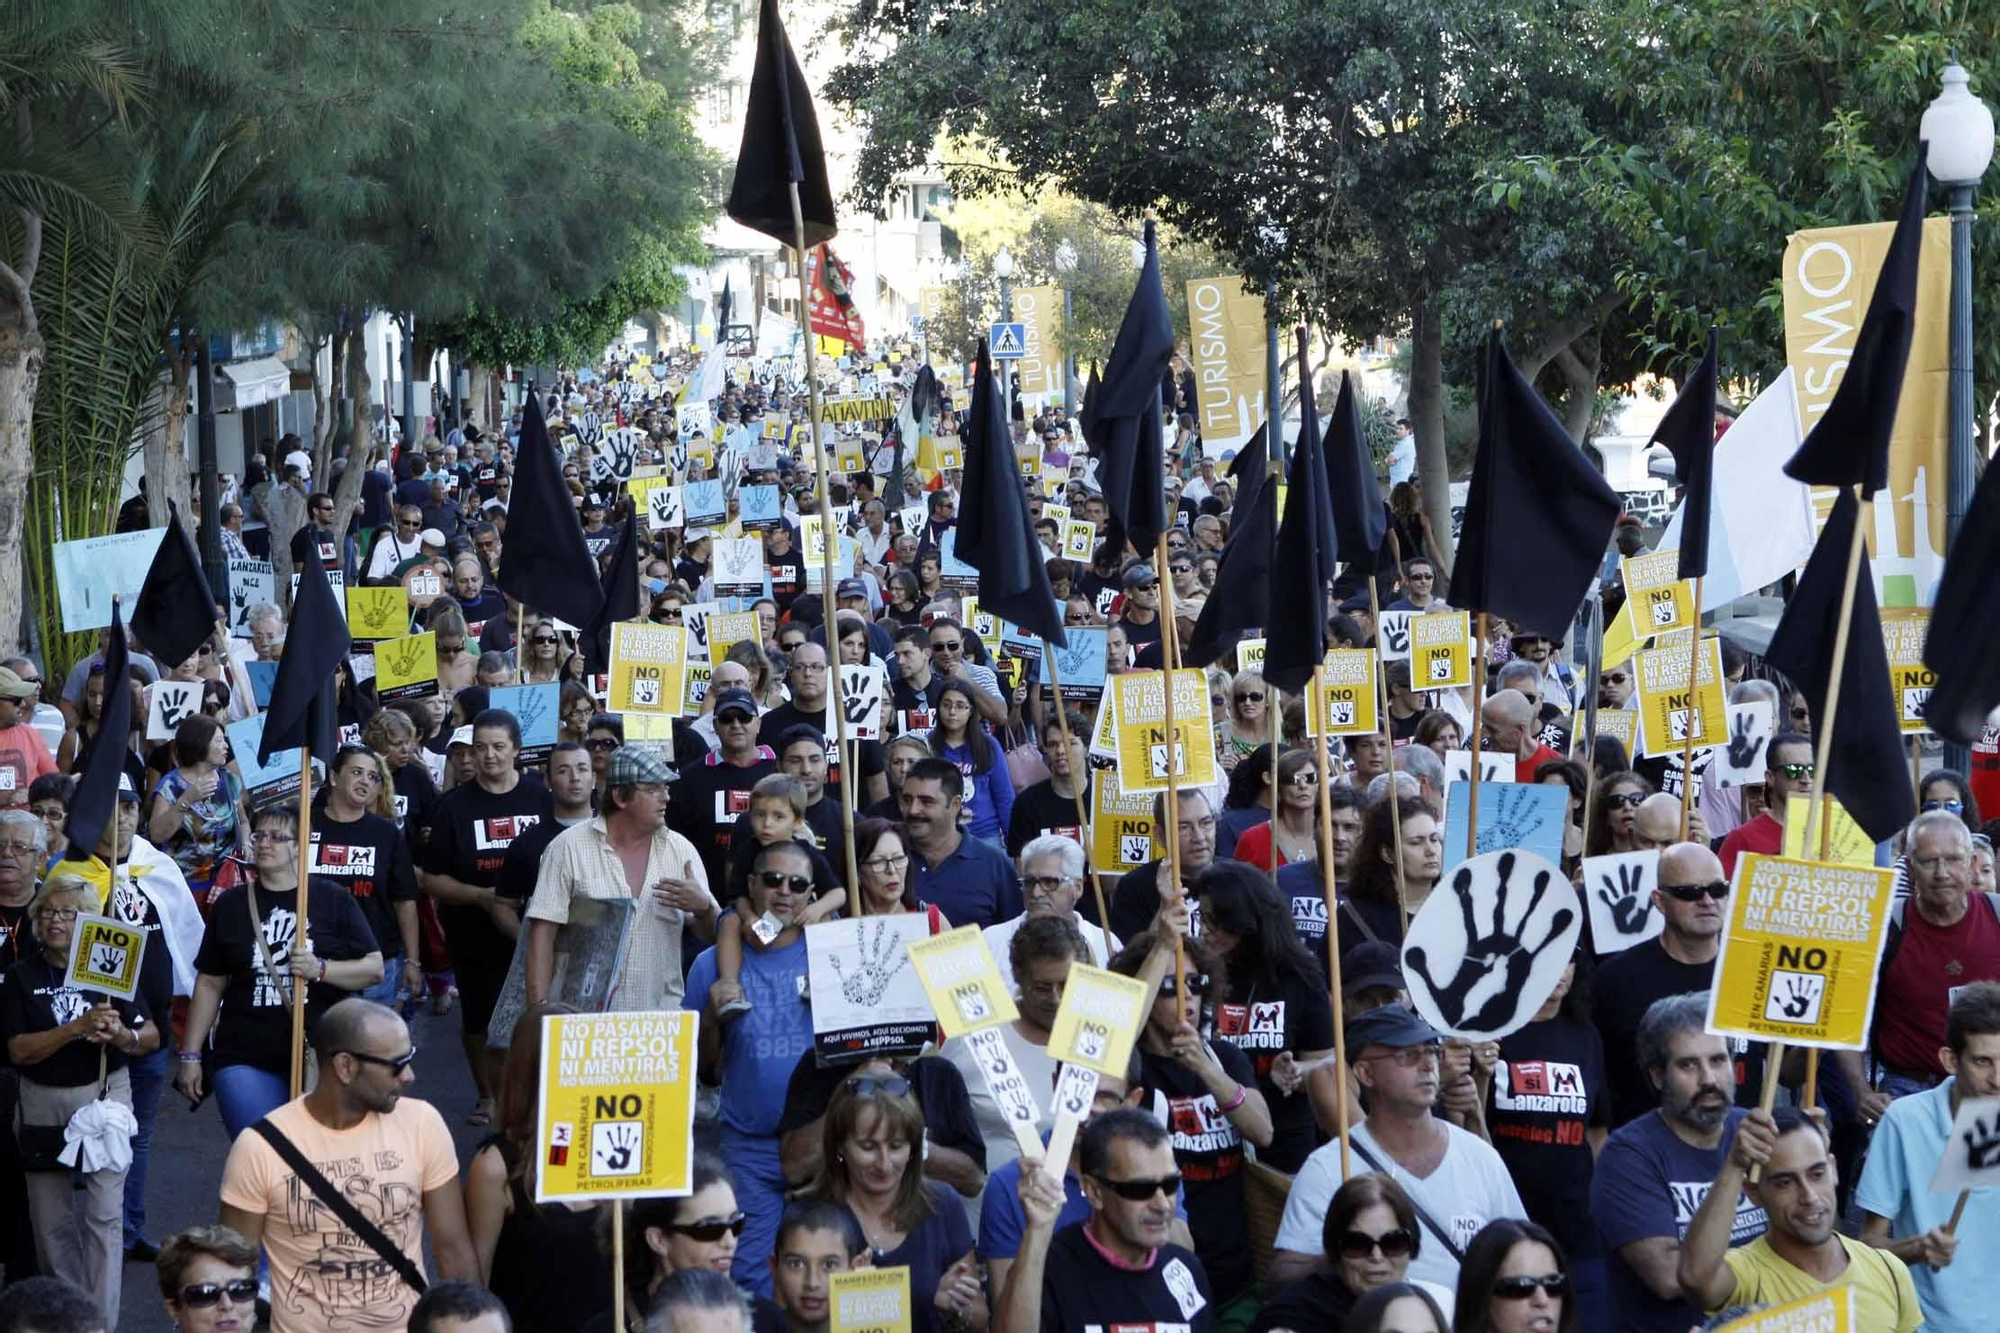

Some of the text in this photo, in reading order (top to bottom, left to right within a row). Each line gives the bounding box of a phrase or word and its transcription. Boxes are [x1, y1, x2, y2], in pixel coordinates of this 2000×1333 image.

[1018, 293, 1042, 386] TURISMO
[1195, 284, 1232, 427] TURISMO
[1050, 509, 1064, 519] NO
[1073, 525, 1089, 535] NO
[1651, 589, 1672, 602] NO
[620, 640, 678, 652] NI REPSOL
[1247, 648, 1264, 660] NO
[1431, 648, 1450, 659] NO
[1643, 656, 1658, 668] NO
[635, 667, 660, 679] NO
[692, 669, 711, 680] NO
[1644, 667, 1658, 678] NI
[1658, 669, 1714, 686] MENTAS
[1904, 671, 1935, 686] NO
[1123, 679, 1197, 696] NO PASRAN
[1331, 689, 1352, 700] NO
[1124, 689, 1200, 708] NI RESOL
[1124, 700, 1201, 718] NI MENIRAS
[1103, 781, 1118, 790] NO
[1103, 790, 1116, 800] NI
[1102, 801, 1113, 810] NI
[1122, 821, 1150, 835] NO
[308, 844, 375, 877] Lanzarote
[1756, 861, 1809, 877] SOMOS
[1752, 872, 1878, 899] NO PASARAN
[1749, 886, 1873, 918] NI REPSOL
[1745, 904, 1873, 932] NI MENTIRAS
[95, 927, 129, 946] NO
[1777, 945, 1827, 971] NO
[1757, 942, 1774, 999] CANARIAS
[955, 983, 979, 997] NO
[1750, 1001, 1762, 1020] EN
[561, 1020, 681, 1038] NO PASARAN
[890, 1025, 928, 1036] DECIDIMOS
[1083, 1020, 1108, 1037] NO
[561, 1036, 680, 1059] NI REPSOL
[864, 1039, 871, 1047] A
[559, 1054, 680, 1076] NI MENTIRAS
[1495, 1060, 1587, 1114] Lanzarote
[595, 1094, 642, 1119] NO
[579, 1096, 590, 1164] CANARIAS
[1556, 1120, 1584, 1145] NO
[577, 1165, 587, 1179] EN
